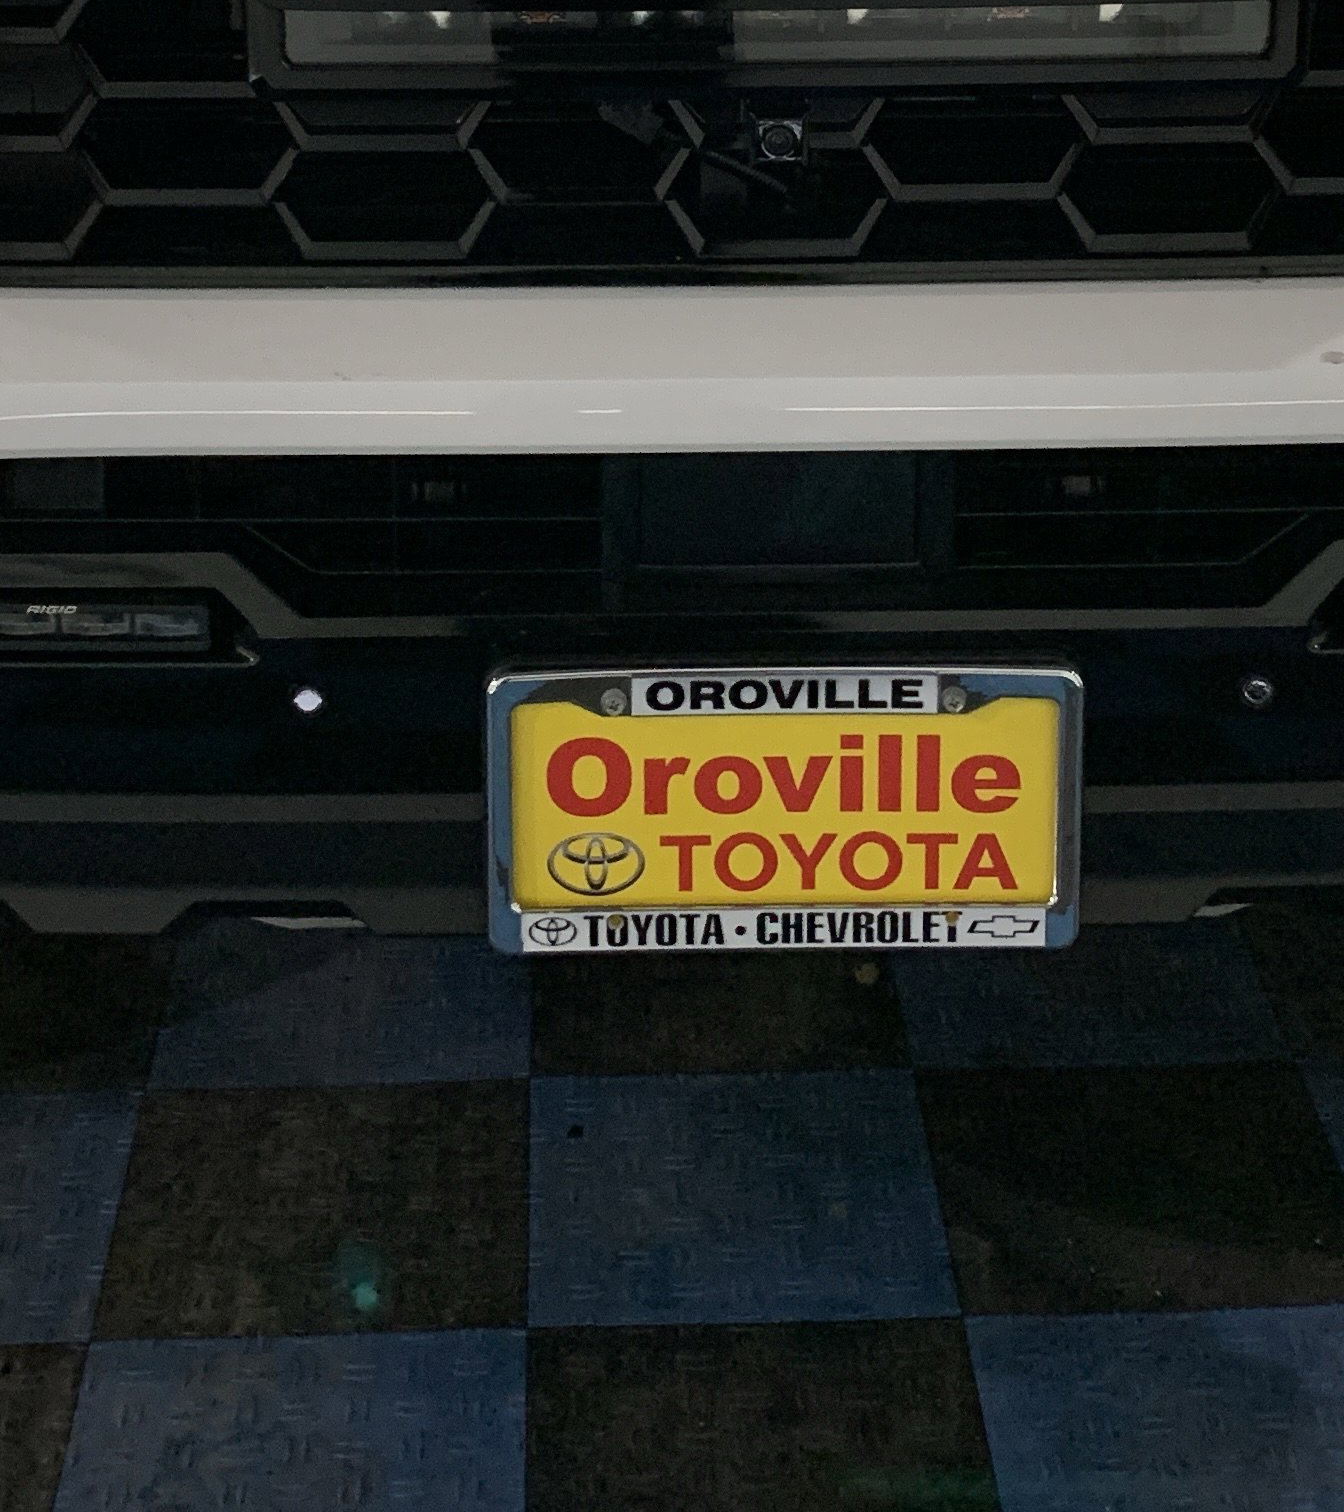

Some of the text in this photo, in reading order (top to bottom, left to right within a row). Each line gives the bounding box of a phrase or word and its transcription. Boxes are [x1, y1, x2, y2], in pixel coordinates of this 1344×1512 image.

[26, 605, 78, 614] RIGID
[645, 678, 925, 711] OROVILLE
[546, 734, 1023, 817] Oroville
[659, 830, 1019, 893] TOYOTA
[584, 910, 963, 947] TOYOTA CHEVROLET
